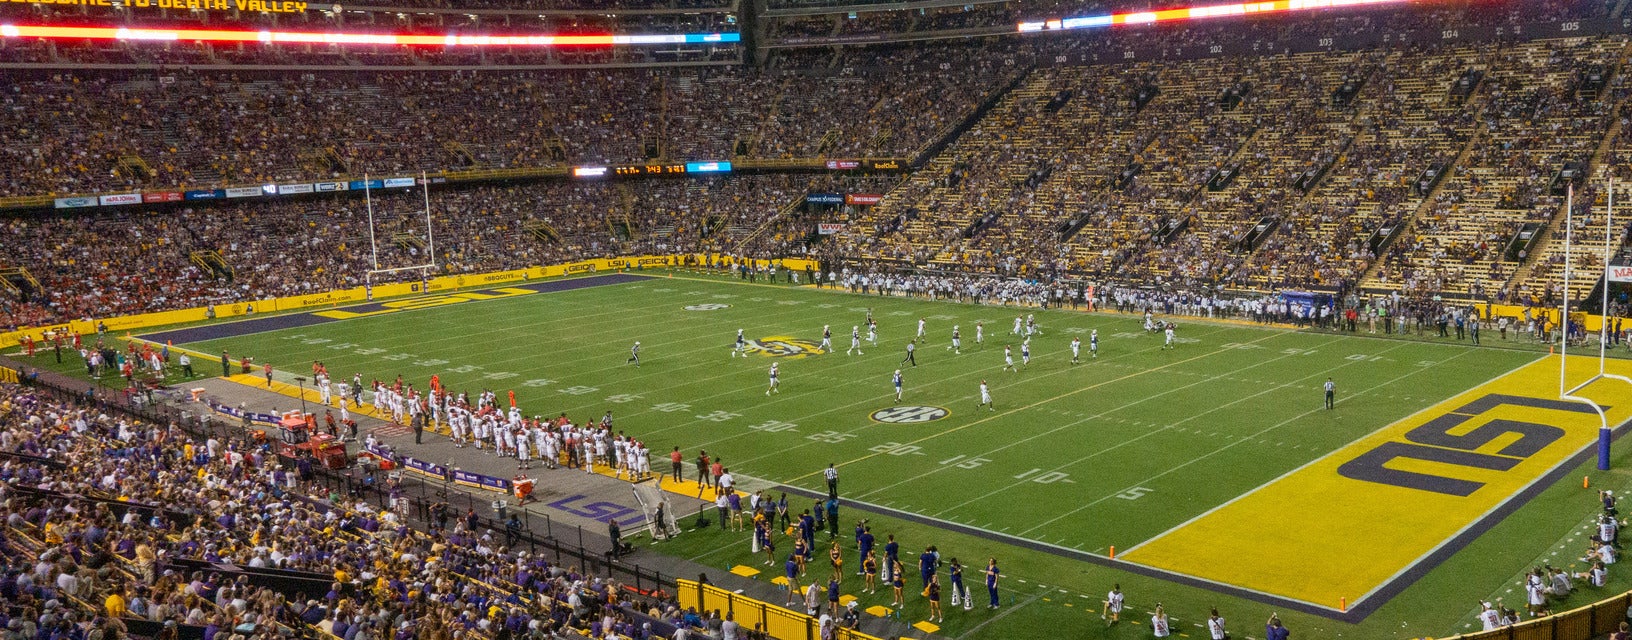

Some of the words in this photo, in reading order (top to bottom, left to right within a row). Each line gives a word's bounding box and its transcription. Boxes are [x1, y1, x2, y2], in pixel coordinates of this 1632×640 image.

[159, 0, 229, 10] DEATH
[236, 0, 307, 13] VALLEY
[1560, 21, 1580, 32] 105
[1442, 29, 1459, 39] 104
[1318, 37, 1333, 47] 103
[1210, 45, 1223, 54] 102
[1055, 55, 1067, 64] 100
[1123, 51, 1135, 60] 101
[607, 259, 625, 268] LSU
[637, 256, 667, 266] GEICO
[568, 263, 596, 272] GEICO
[1336, 393, 1613, 498] LSU
[1116, 486, 1153, 501] 5
[547, 494, 649, 526] LSU
